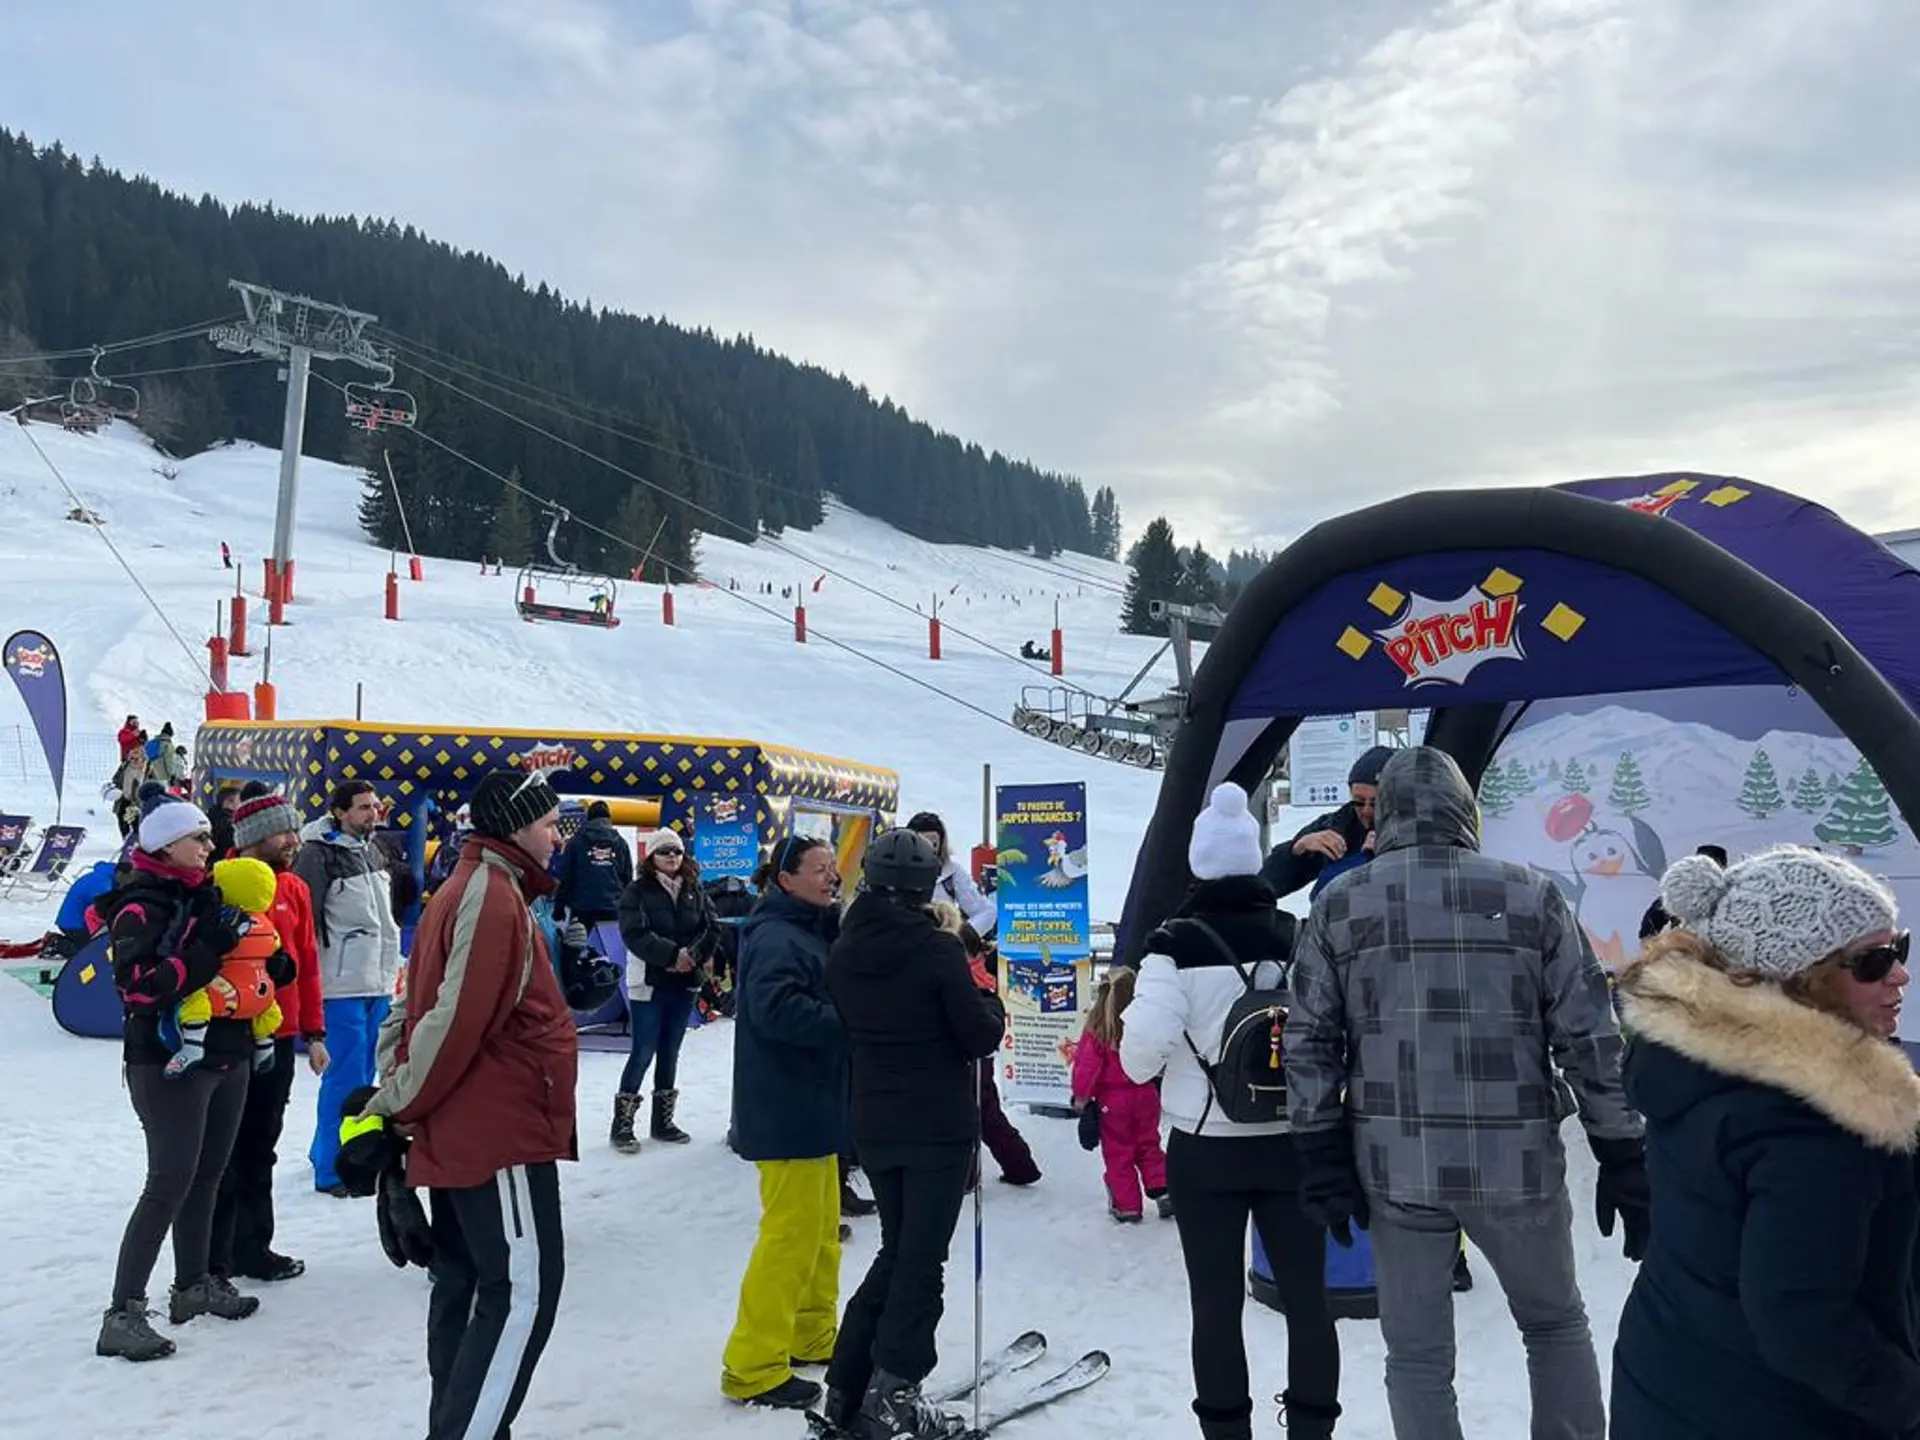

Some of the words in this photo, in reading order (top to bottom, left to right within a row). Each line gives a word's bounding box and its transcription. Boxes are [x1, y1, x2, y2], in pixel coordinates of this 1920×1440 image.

[1002, 812, 1030, 824] SUPER
[1031, 812, 1074, 823] VACANCES
[1005, 1034, 1013, 1050] 2
[1005, 1065, 1013, 1079] 3
